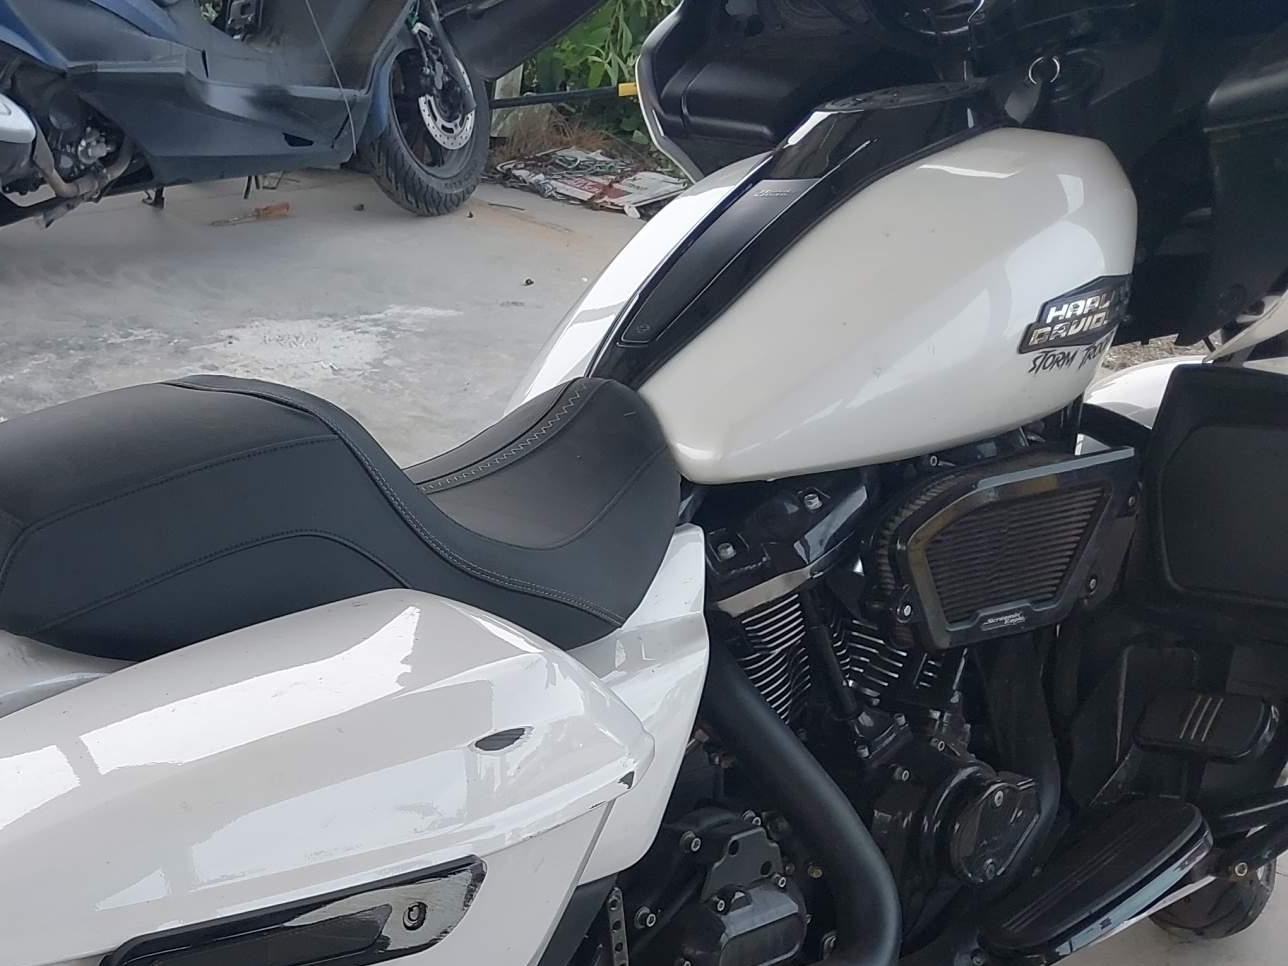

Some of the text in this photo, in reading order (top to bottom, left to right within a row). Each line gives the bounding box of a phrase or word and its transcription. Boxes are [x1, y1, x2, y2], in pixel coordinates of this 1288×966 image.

[1046, 293, 1112, 324] HARL
[1028, 311, 1108, 346] DAVID
[1028, 349, 1078, 374] STORM
